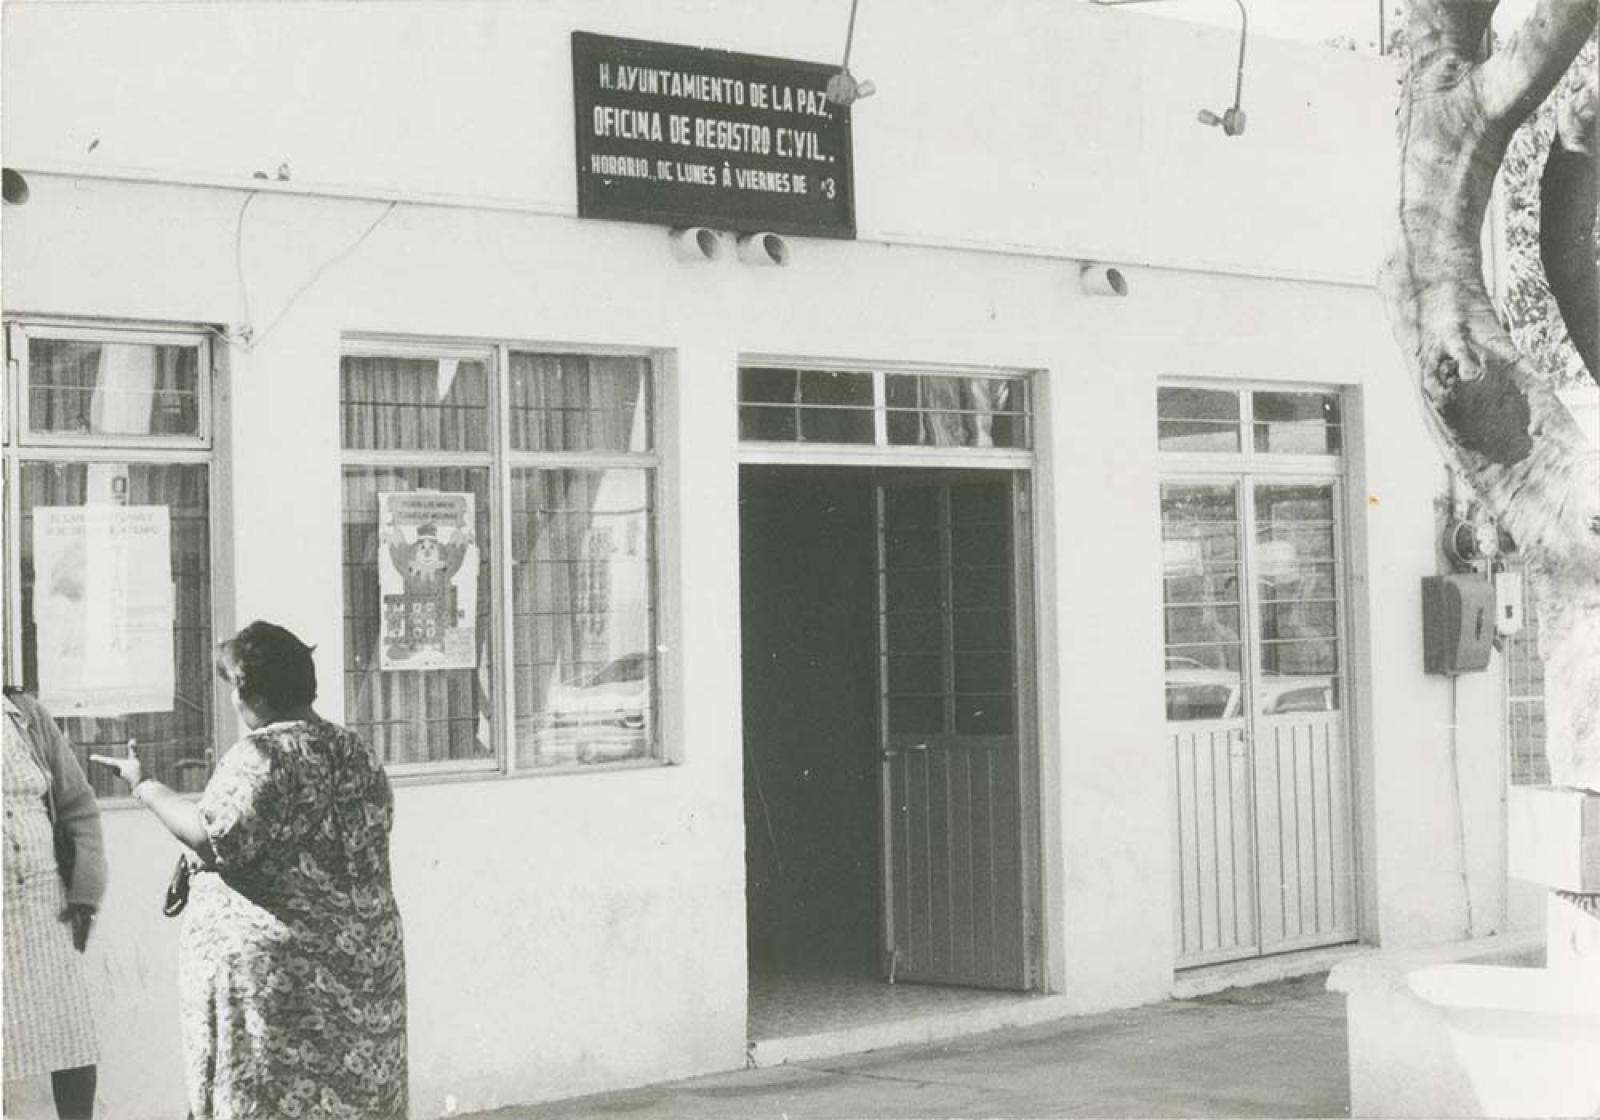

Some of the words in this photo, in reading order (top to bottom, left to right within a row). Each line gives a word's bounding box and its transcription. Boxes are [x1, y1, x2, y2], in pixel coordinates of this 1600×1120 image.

[749, 82, 769, 109] DE
[772, 85, 793, 112] LA
[593, 105, 663, 142] OFICINA
[669, 115, 691, 145] DE
[695, 117, 771, 155] REGISTRO
[677, 162, 717, 186] LUNES
[736, 167, 791, 193] VIERNES
[792, 173, 808, 195] DE
